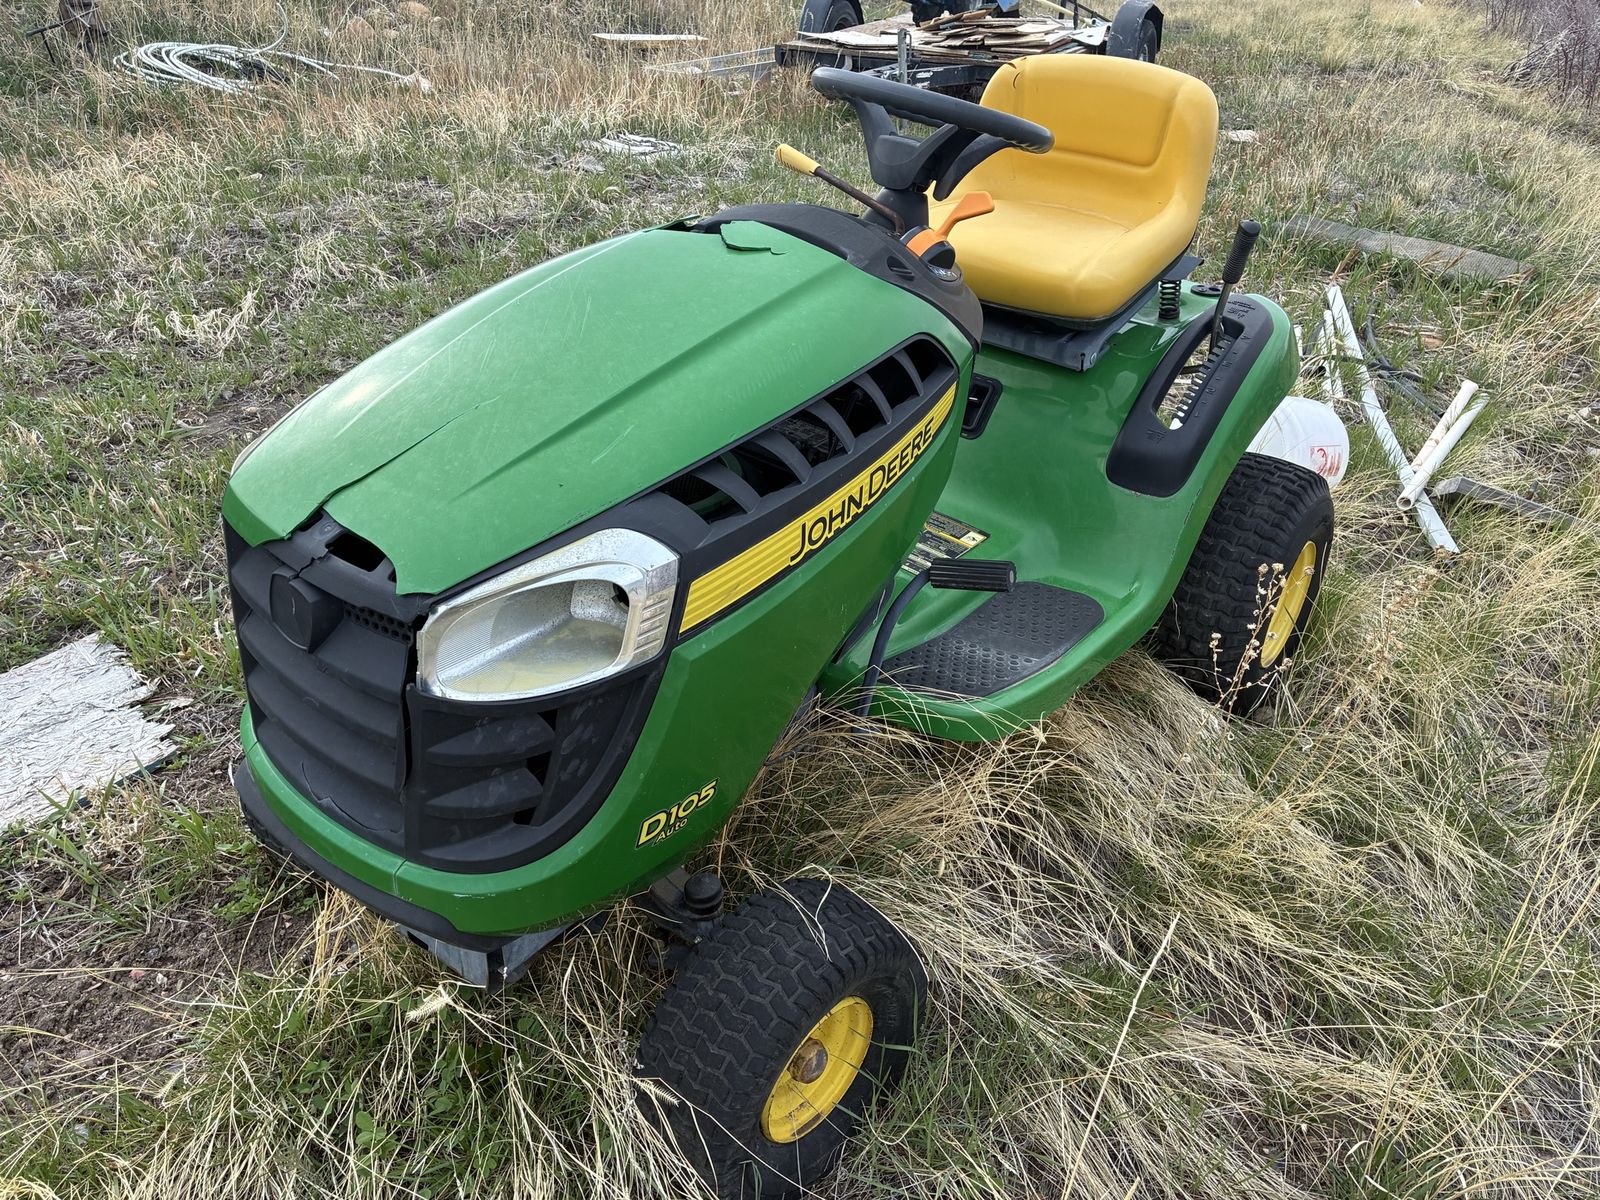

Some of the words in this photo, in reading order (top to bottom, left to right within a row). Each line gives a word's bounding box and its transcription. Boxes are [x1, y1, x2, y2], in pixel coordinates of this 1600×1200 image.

[789, 485, 864, 563] JOHN
[869, 416, 935, 500] DEERE
[637, 778, 718, 847] D105
